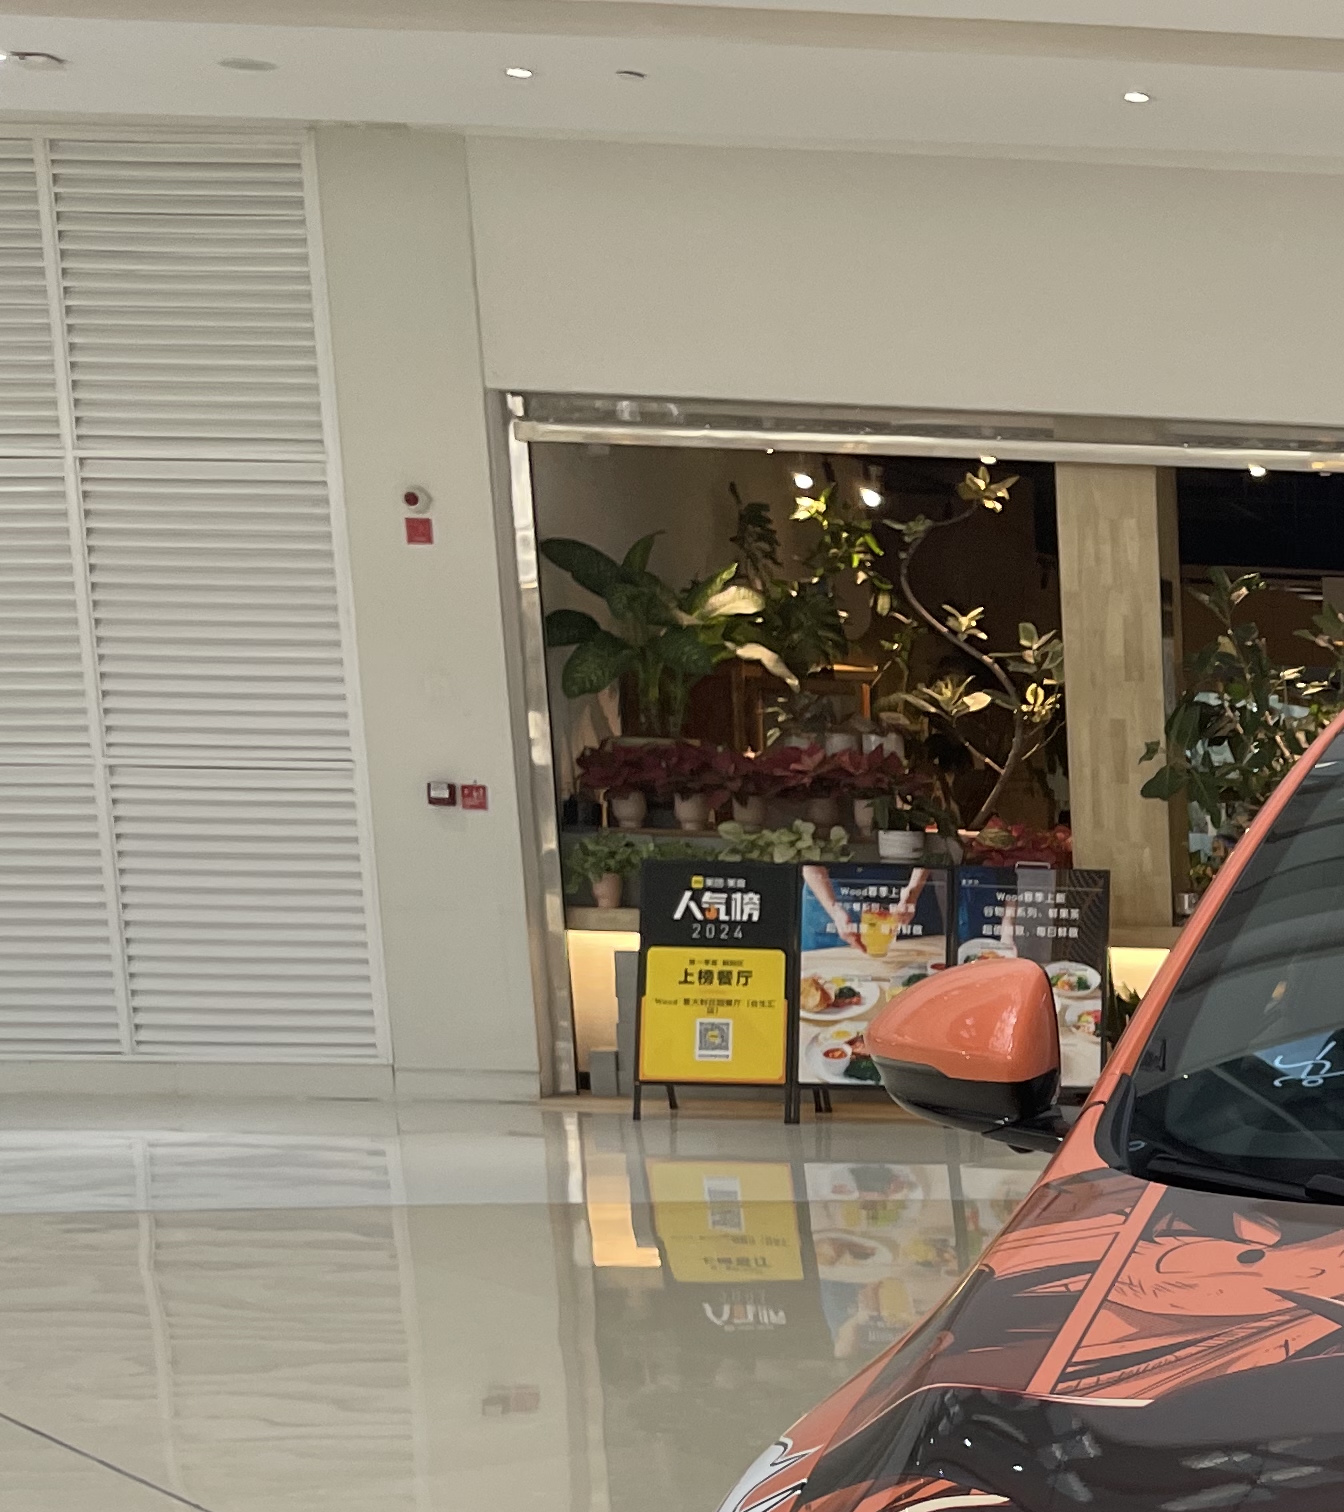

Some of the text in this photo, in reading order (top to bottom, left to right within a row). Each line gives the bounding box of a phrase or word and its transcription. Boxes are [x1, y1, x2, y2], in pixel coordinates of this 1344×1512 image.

[673, 890, 761, 922] 人气榜
[691, 923, 743, 940] 2024
[678, 967, 753, 987] 上榜餐厅
